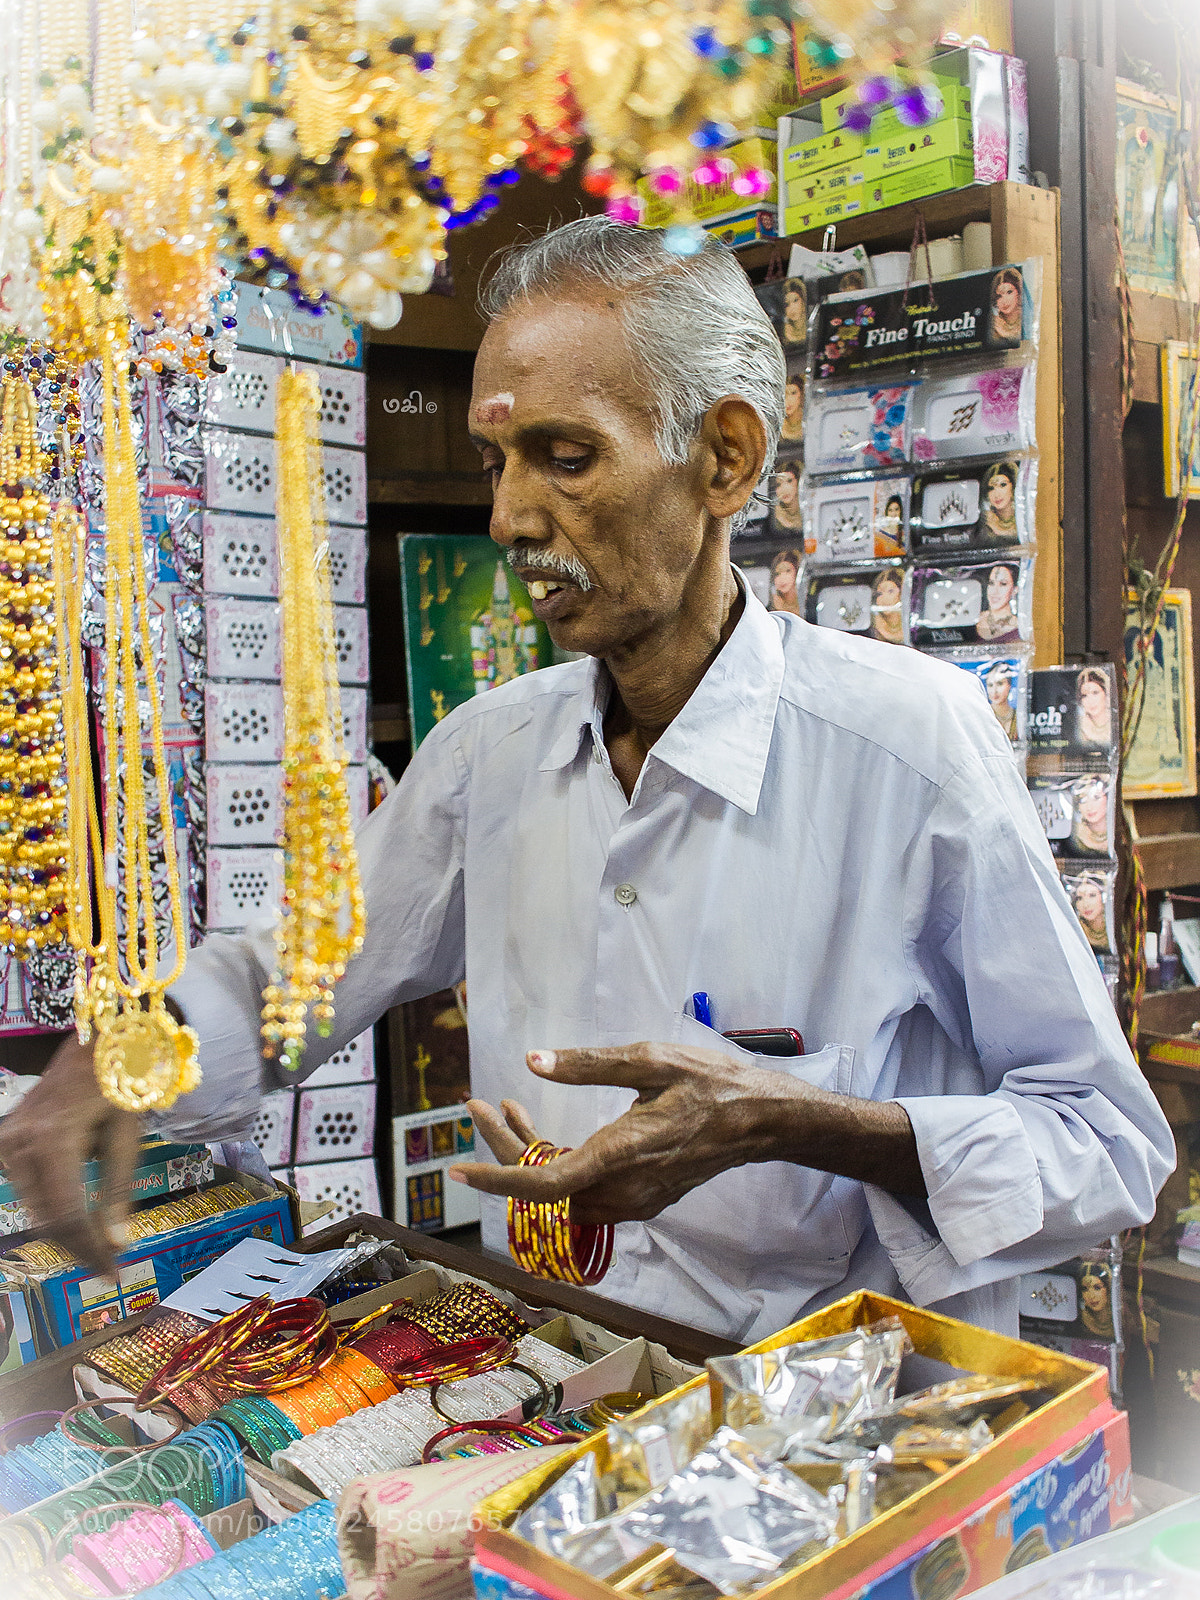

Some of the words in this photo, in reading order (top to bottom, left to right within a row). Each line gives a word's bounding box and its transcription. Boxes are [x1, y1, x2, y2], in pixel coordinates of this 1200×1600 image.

[864, 326, 909, 348] Fine
[913, 311, 976, 338] Touch
[130, 1173, 165, 1191] Nylon
[171, 1250, 203, 1264] PRODUCTS
[129, 1281, 150, 1291] COLOUR
[131, 1295, 154, 1309] JUMBO
